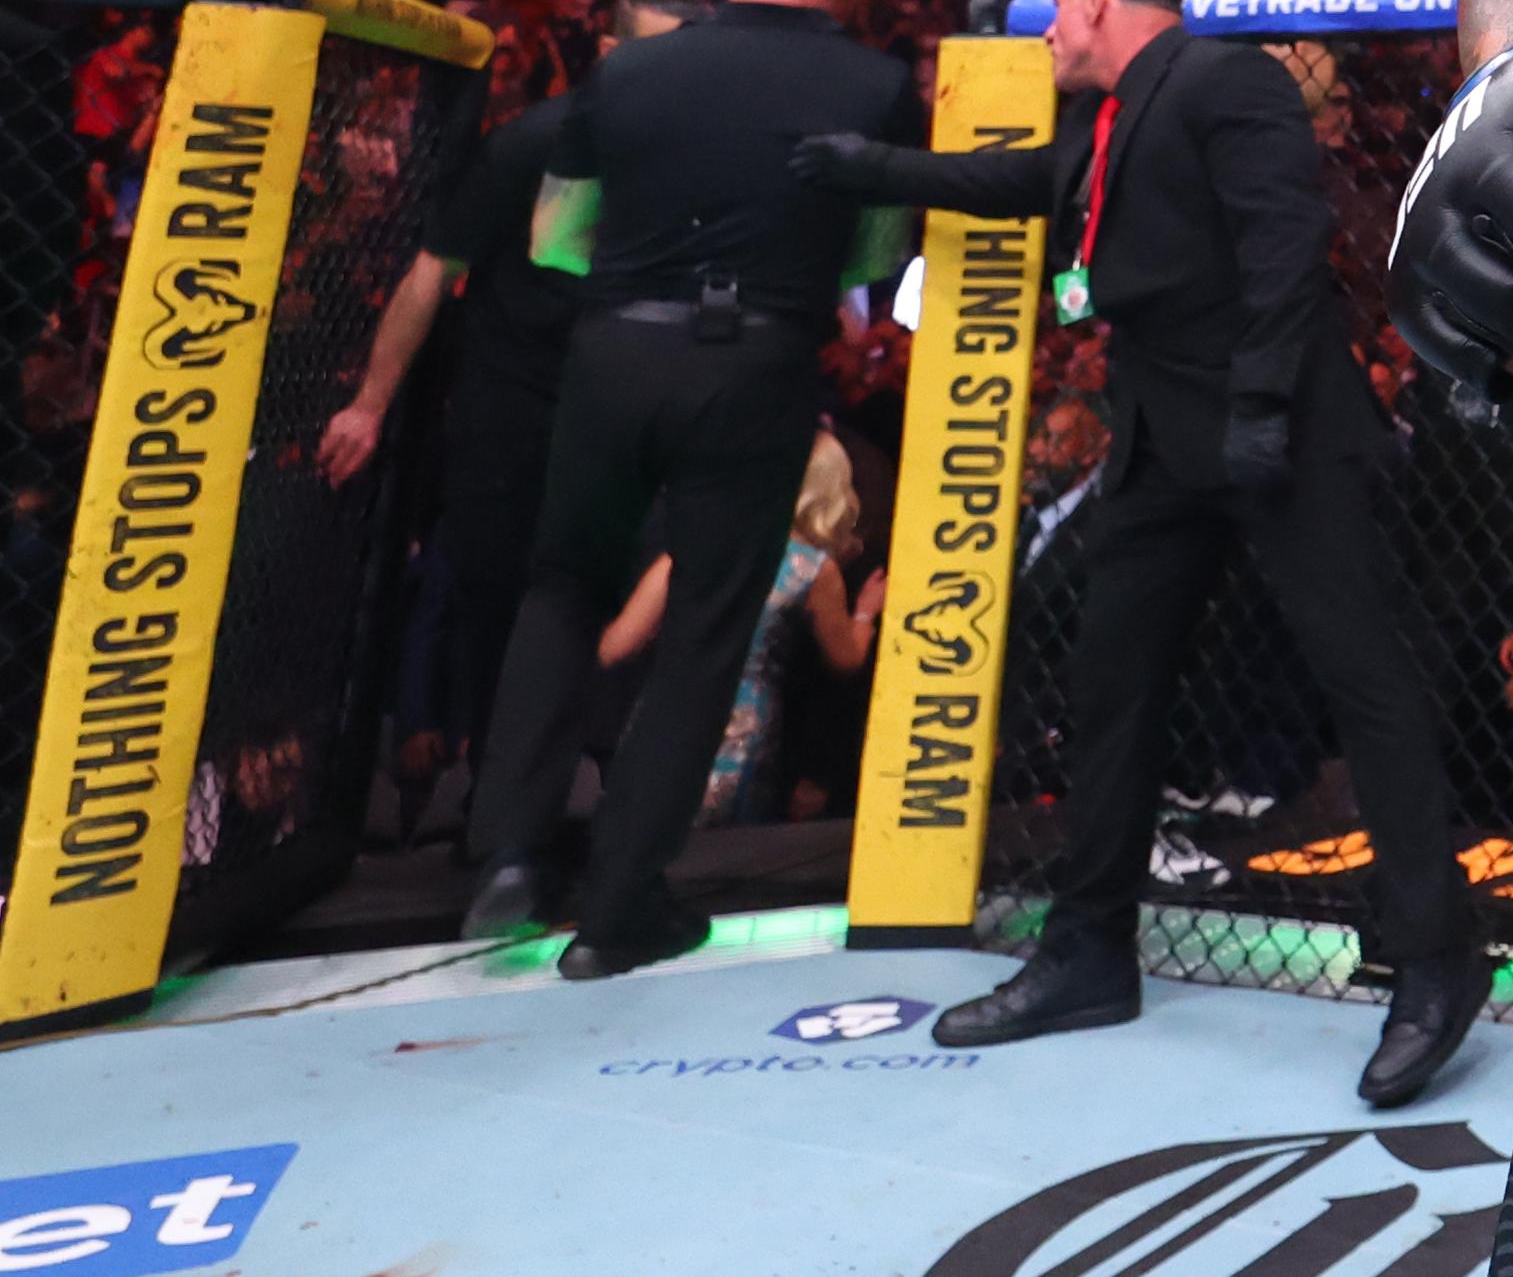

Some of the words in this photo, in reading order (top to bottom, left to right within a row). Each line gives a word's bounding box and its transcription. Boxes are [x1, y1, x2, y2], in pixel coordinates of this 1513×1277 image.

[167, 103, 274, 240] RAM
[954, 124, 1044, 355] NHING
[111, 387, 217, 595] STOPS
[933, 374, 1014, 554] STOPS
[50, 611, 180, 907] NOTHING
[897, 693, 980, 829] RAM
[598, 1053, 981, 1078] crypto.com
